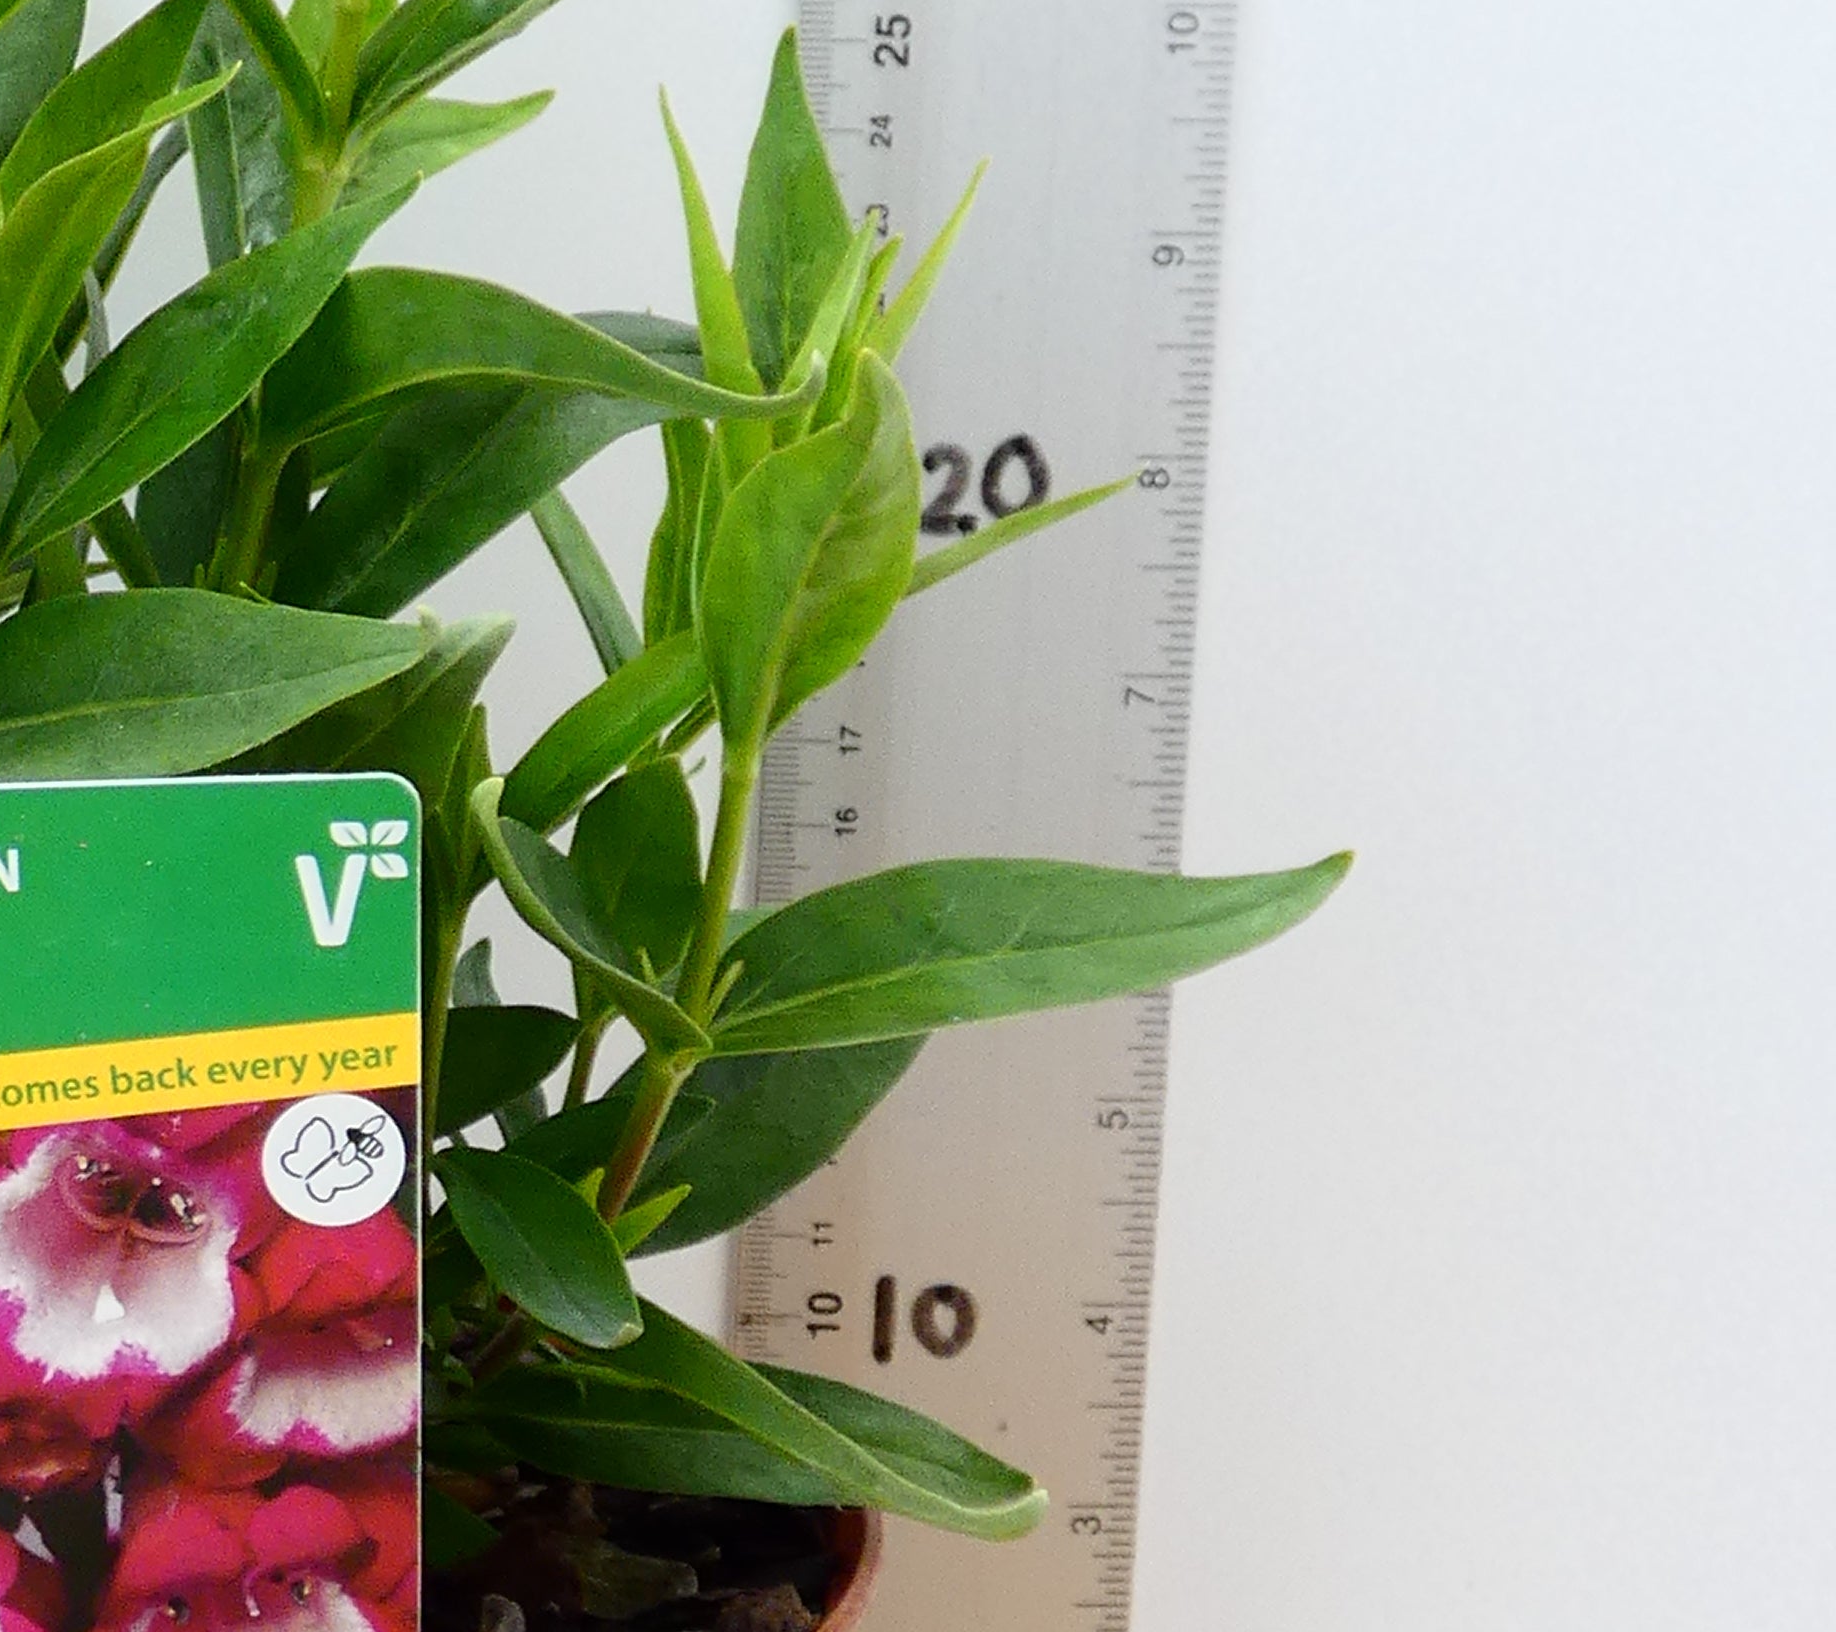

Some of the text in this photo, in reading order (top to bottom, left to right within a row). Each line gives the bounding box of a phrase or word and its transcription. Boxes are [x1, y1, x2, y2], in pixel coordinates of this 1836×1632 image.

[875, 14, 910, 67] 25
[1168, 11, 1200, 53] 10
[870, 114, 892, 147] 24
[1152, 244, 1184, 266] 9
[922, 433, 1051, 534] 20
[1139, 467, 1170, 489] 8
[1124, 687, 1156, 708] 7
[839, 725, 862, 755] 17
[835, 807, 858, 836] 16
[110, 1056, 197, 1095] back
[206, 1050, 309, 1086] every
[318, 1042, 400, 1080] year
[1098, 1107, 1130, 1130] 5
[812, 1221, 833, 1246] 11
[808, 1292, 843, 1337] 10
[873, 1275, 977, 1363] 10
[1087, 1315, 1112, 1334] 4
[1071, 1516, 1102, 1535] 3
